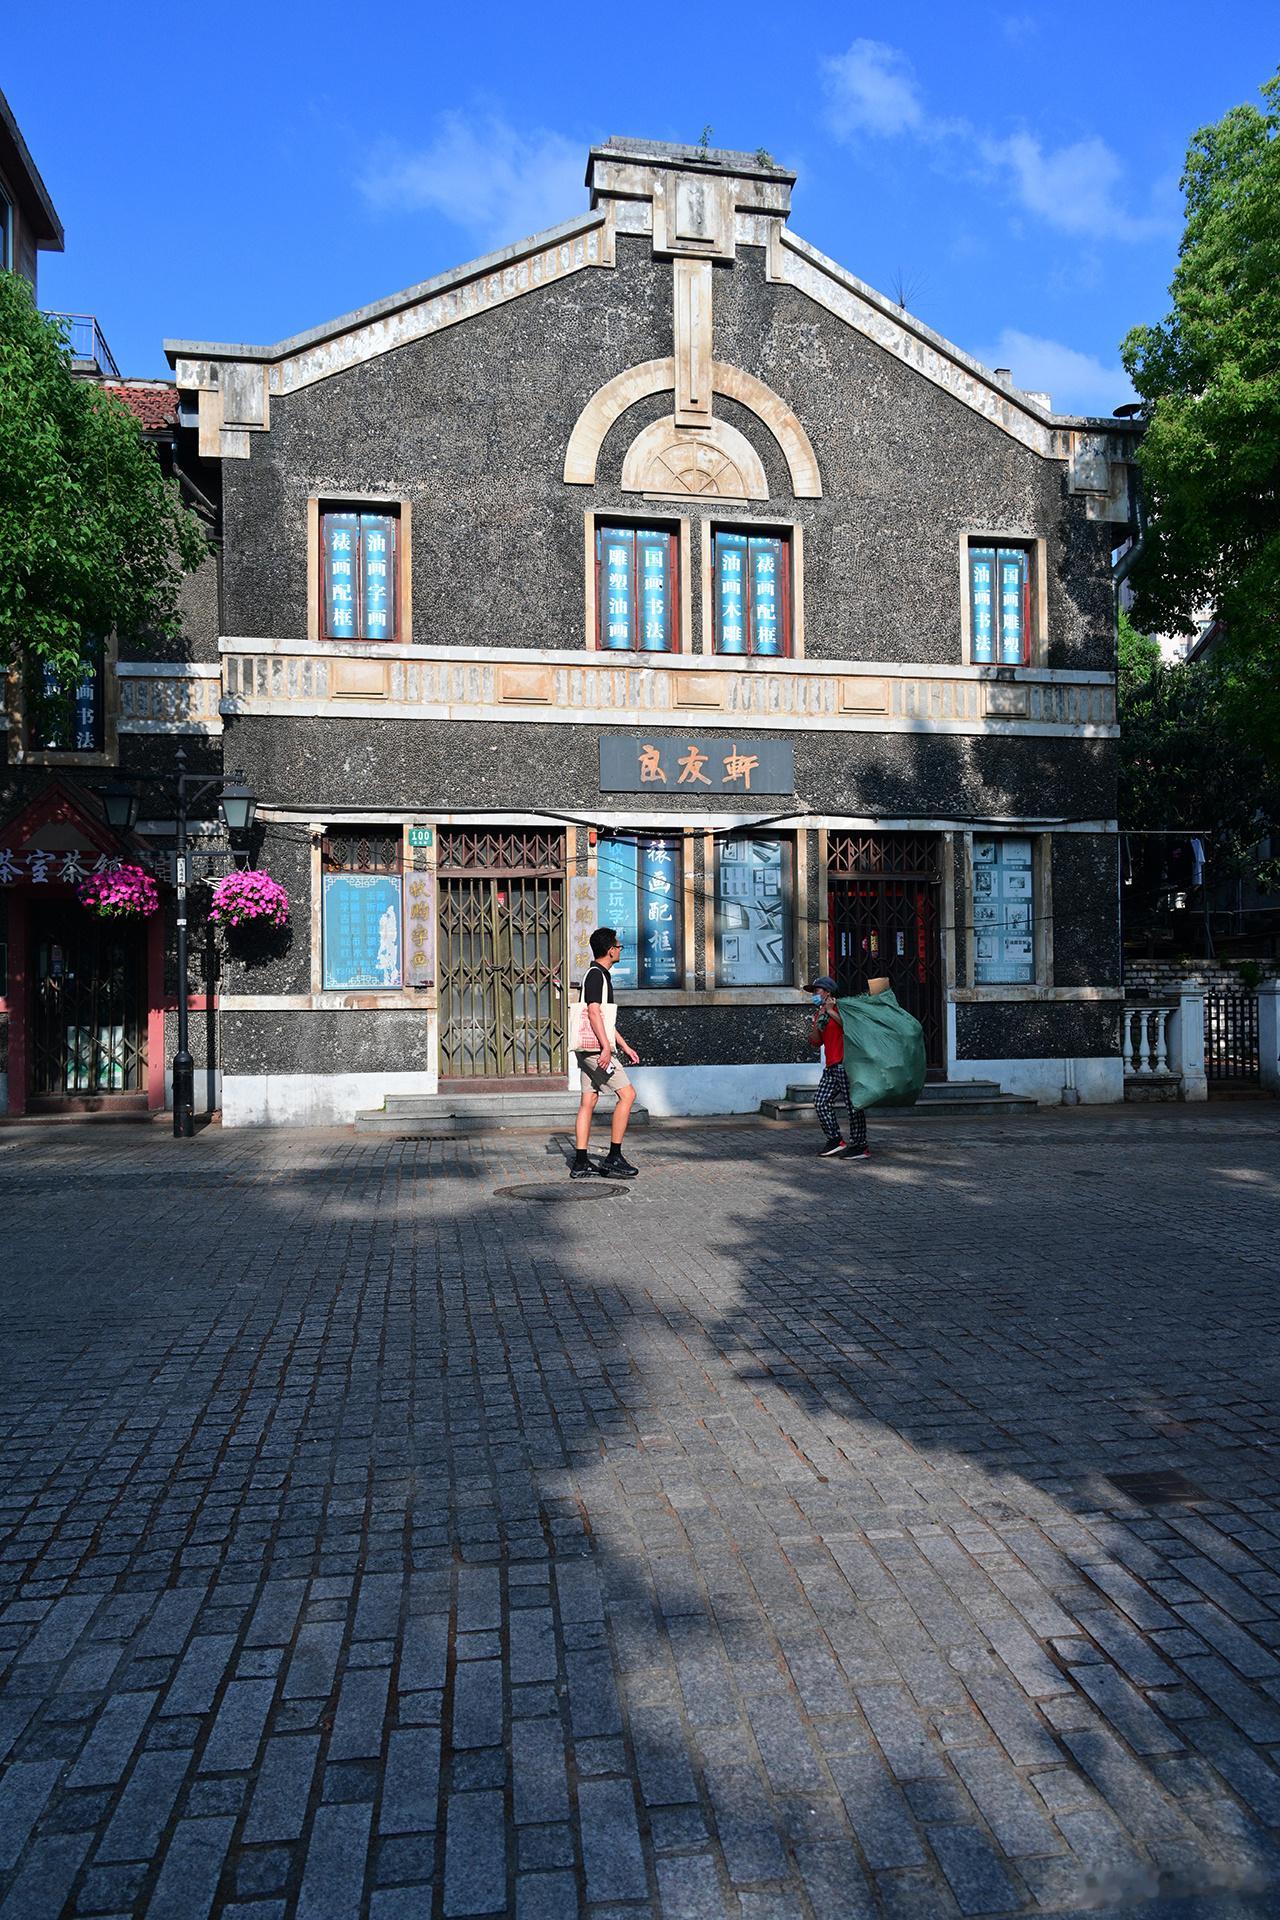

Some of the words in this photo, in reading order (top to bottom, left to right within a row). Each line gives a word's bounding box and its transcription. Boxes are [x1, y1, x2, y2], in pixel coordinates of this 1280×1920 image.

[331, 532, 353, 627] 裱画配框
[367, 533, 387, 627] 油画字画
[608, 549, 628, 638] 雕塑油画
[644, 550, 664, 639] 国画书法
[722, 554, 742, 642] 油画木雕
[756, 556, 776, 643] 裱画配框
[974, 566, 991, 651] 油画书法
[1003, 567, 1019, 652] 国画雕塑
[412, 831, 430, 841] 100
[646, 839, 673, 953] 裱画配框
